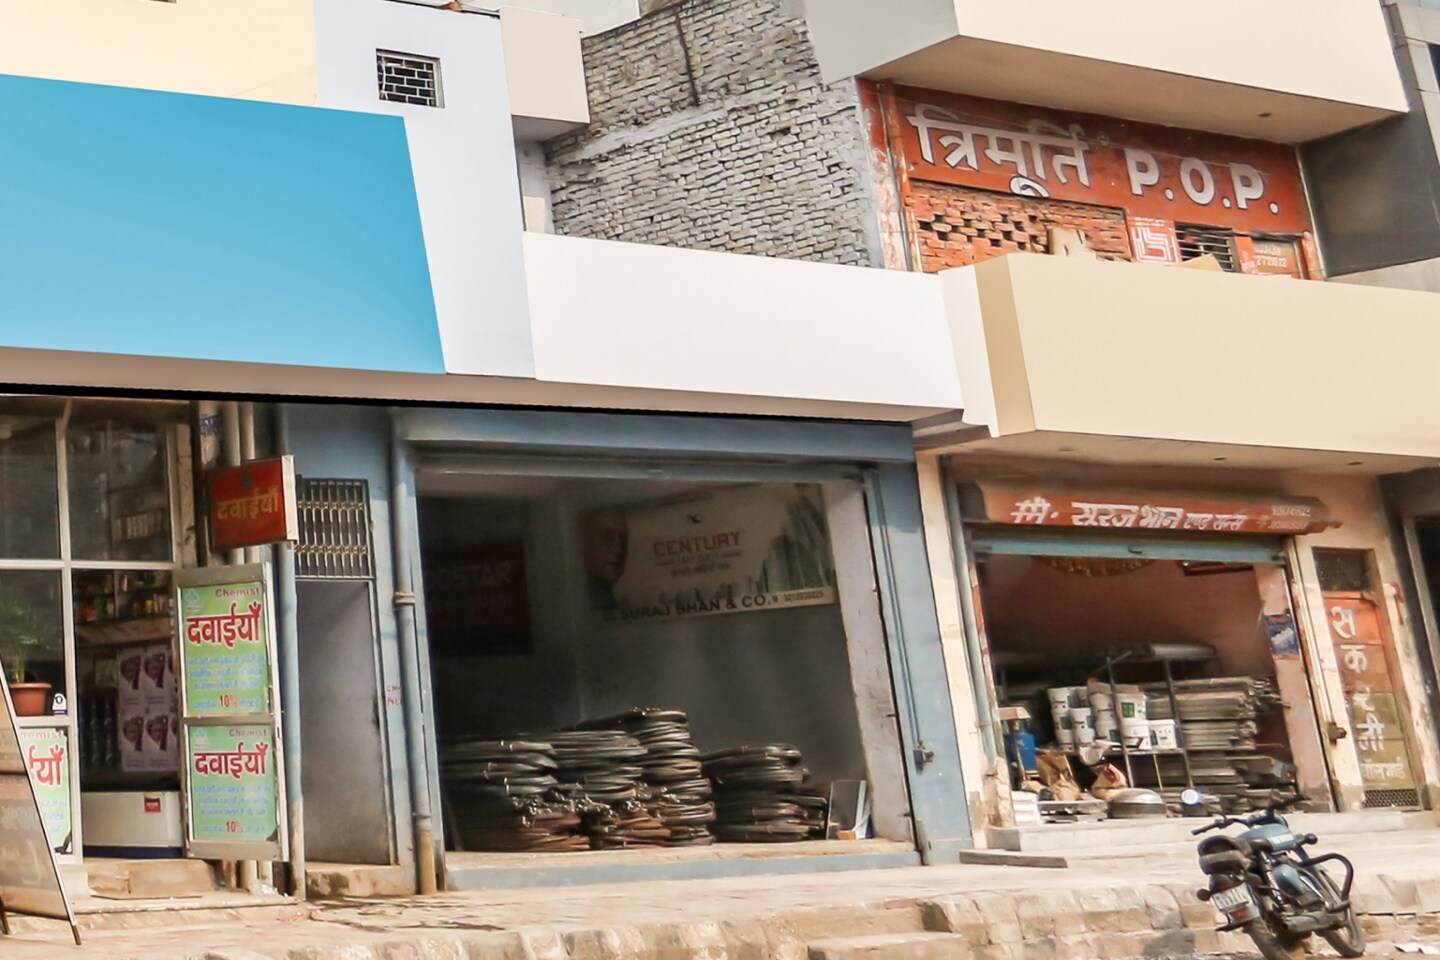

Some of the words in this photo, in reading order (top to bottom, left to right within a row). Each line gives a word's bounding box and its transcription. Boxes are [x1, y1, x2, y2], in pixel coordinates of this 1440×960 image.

[907, 103, 1091, 198] त्रिमूर्ति
[1124, 147, 1280, 214] P.O.P.
[653, 530, 741, 557] CENTURY
[215, 587, 260, 598] Chemist
[675, 599, 721, 616] BHAN
[741, 593, 772, 608] CO.
